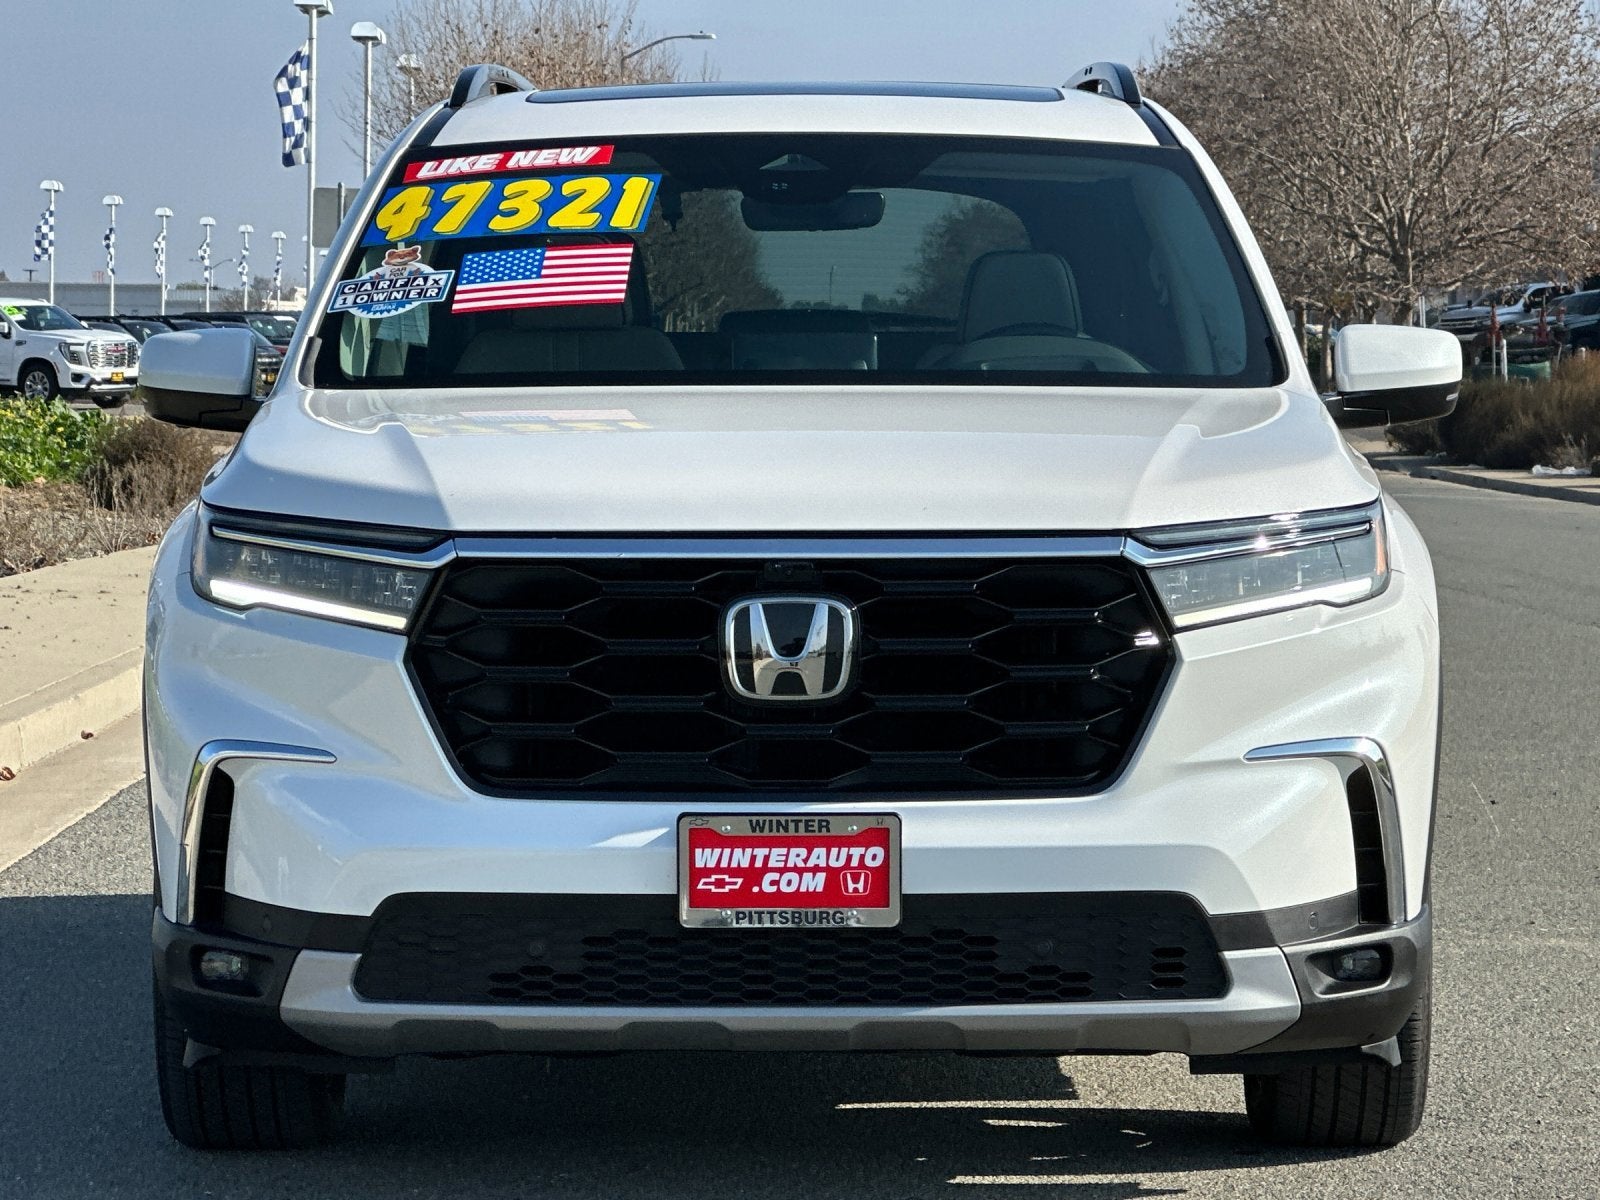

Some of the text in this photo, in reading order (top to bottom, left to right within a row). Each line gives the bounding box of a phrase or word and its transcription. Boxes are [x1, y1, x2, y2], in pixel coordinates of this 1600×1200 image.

[415, 146, 602, 179] LIKE NEW
[376, 176, 655, 242] 47321
[343, 278, 443, 294] CARFAX
[355, 288, 440, 304] OWNER
[748, 819, 831, 834] WINTER
[694, 846, 885, 868] WINTERAUTO
[752, 872, 826, 893] .COM
[735, 910, 845, 925] PITTSBURG
